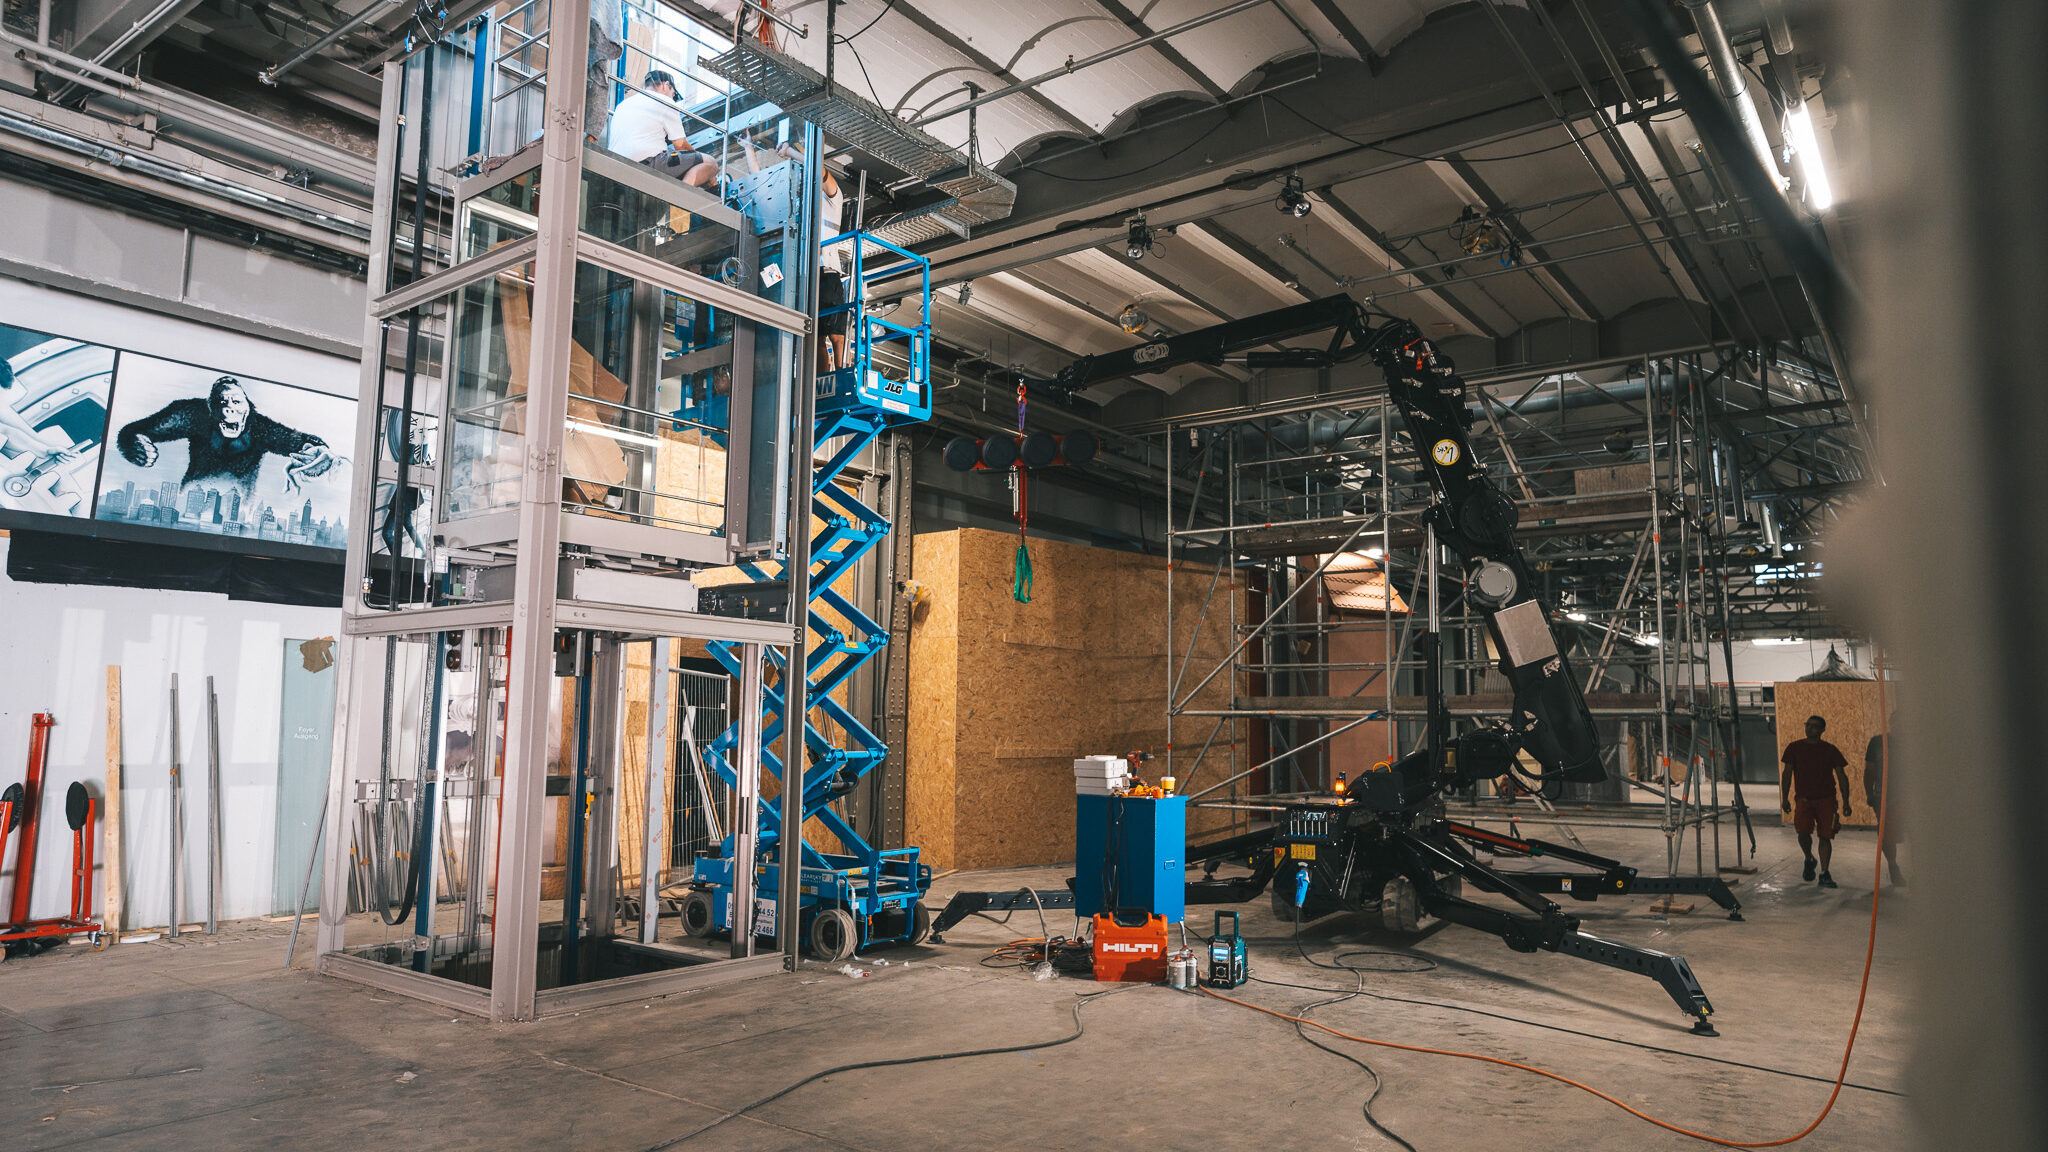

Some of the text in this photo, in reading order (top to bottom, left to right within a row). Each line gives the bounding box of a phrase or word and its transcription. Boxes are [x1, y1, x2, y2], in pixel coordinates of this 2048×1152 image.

[884, 382, 903, 395] JLG
[767, 908, 775, 917] 52
[1103, 943, 1158, 952] HILTI
